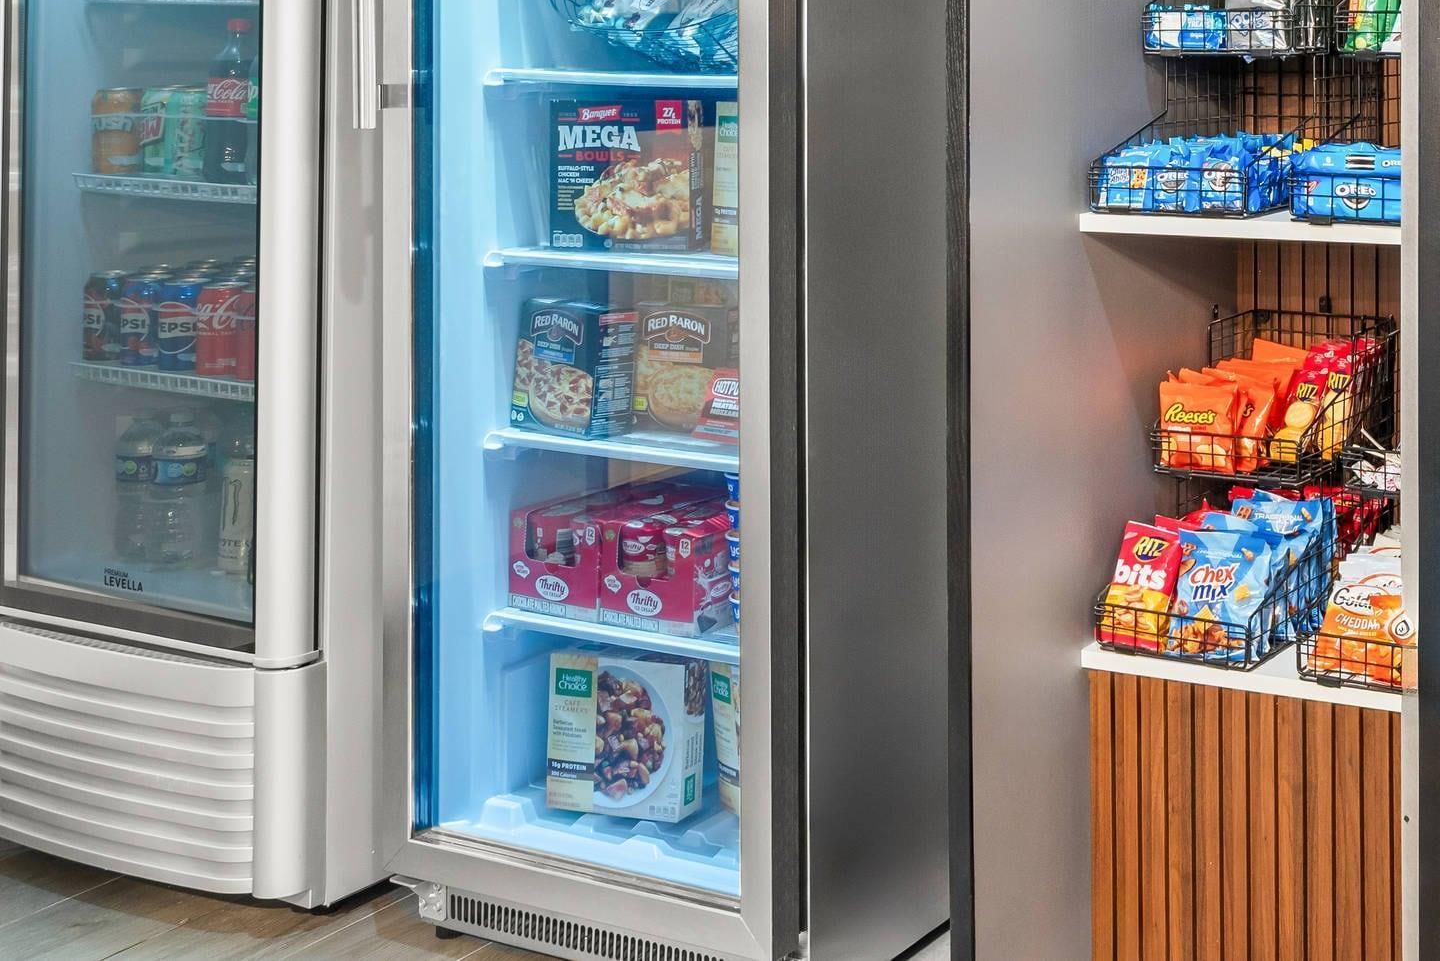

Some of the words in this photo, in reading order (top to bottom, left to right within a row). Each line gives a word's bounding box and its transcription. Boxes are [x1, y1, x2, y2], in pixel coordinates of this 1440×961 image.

[582, 108, 617, 121] Banquet
[558, 125, 640, 151] MEGA
[576, 151, 625, 162] BOWLS
[1335, 184, 1376, 197] OREO
[534, 315, 550, 328] RED
[551, 315, 579, 334] BARON
[649, 317, 668, 332] RED
[669, 315, 705, 334] BARON
[1328, 372, 1350, 389] RITZ
[1297, 383, 1318, 400] RITZ
[1164, 403, 1216, 425] Reese's
[587, 530, 594, 538] 12
[680, 541, 689, 550] 12
[1134, 536, 1169, 558] RITZ
[1115, 559, 1167, 591] bits
[1190, 564, 1239, 585] Chex
[104, 575, 143, 592] LEVELLA
[539, 579, 566, 596] Thrifty
[1193, 583, 1233, 603] mix
[631, 593, 658, 611] Thrifty
[559, 681, 588, 691] Choice
[562, 673, 587, 683] Healthy
